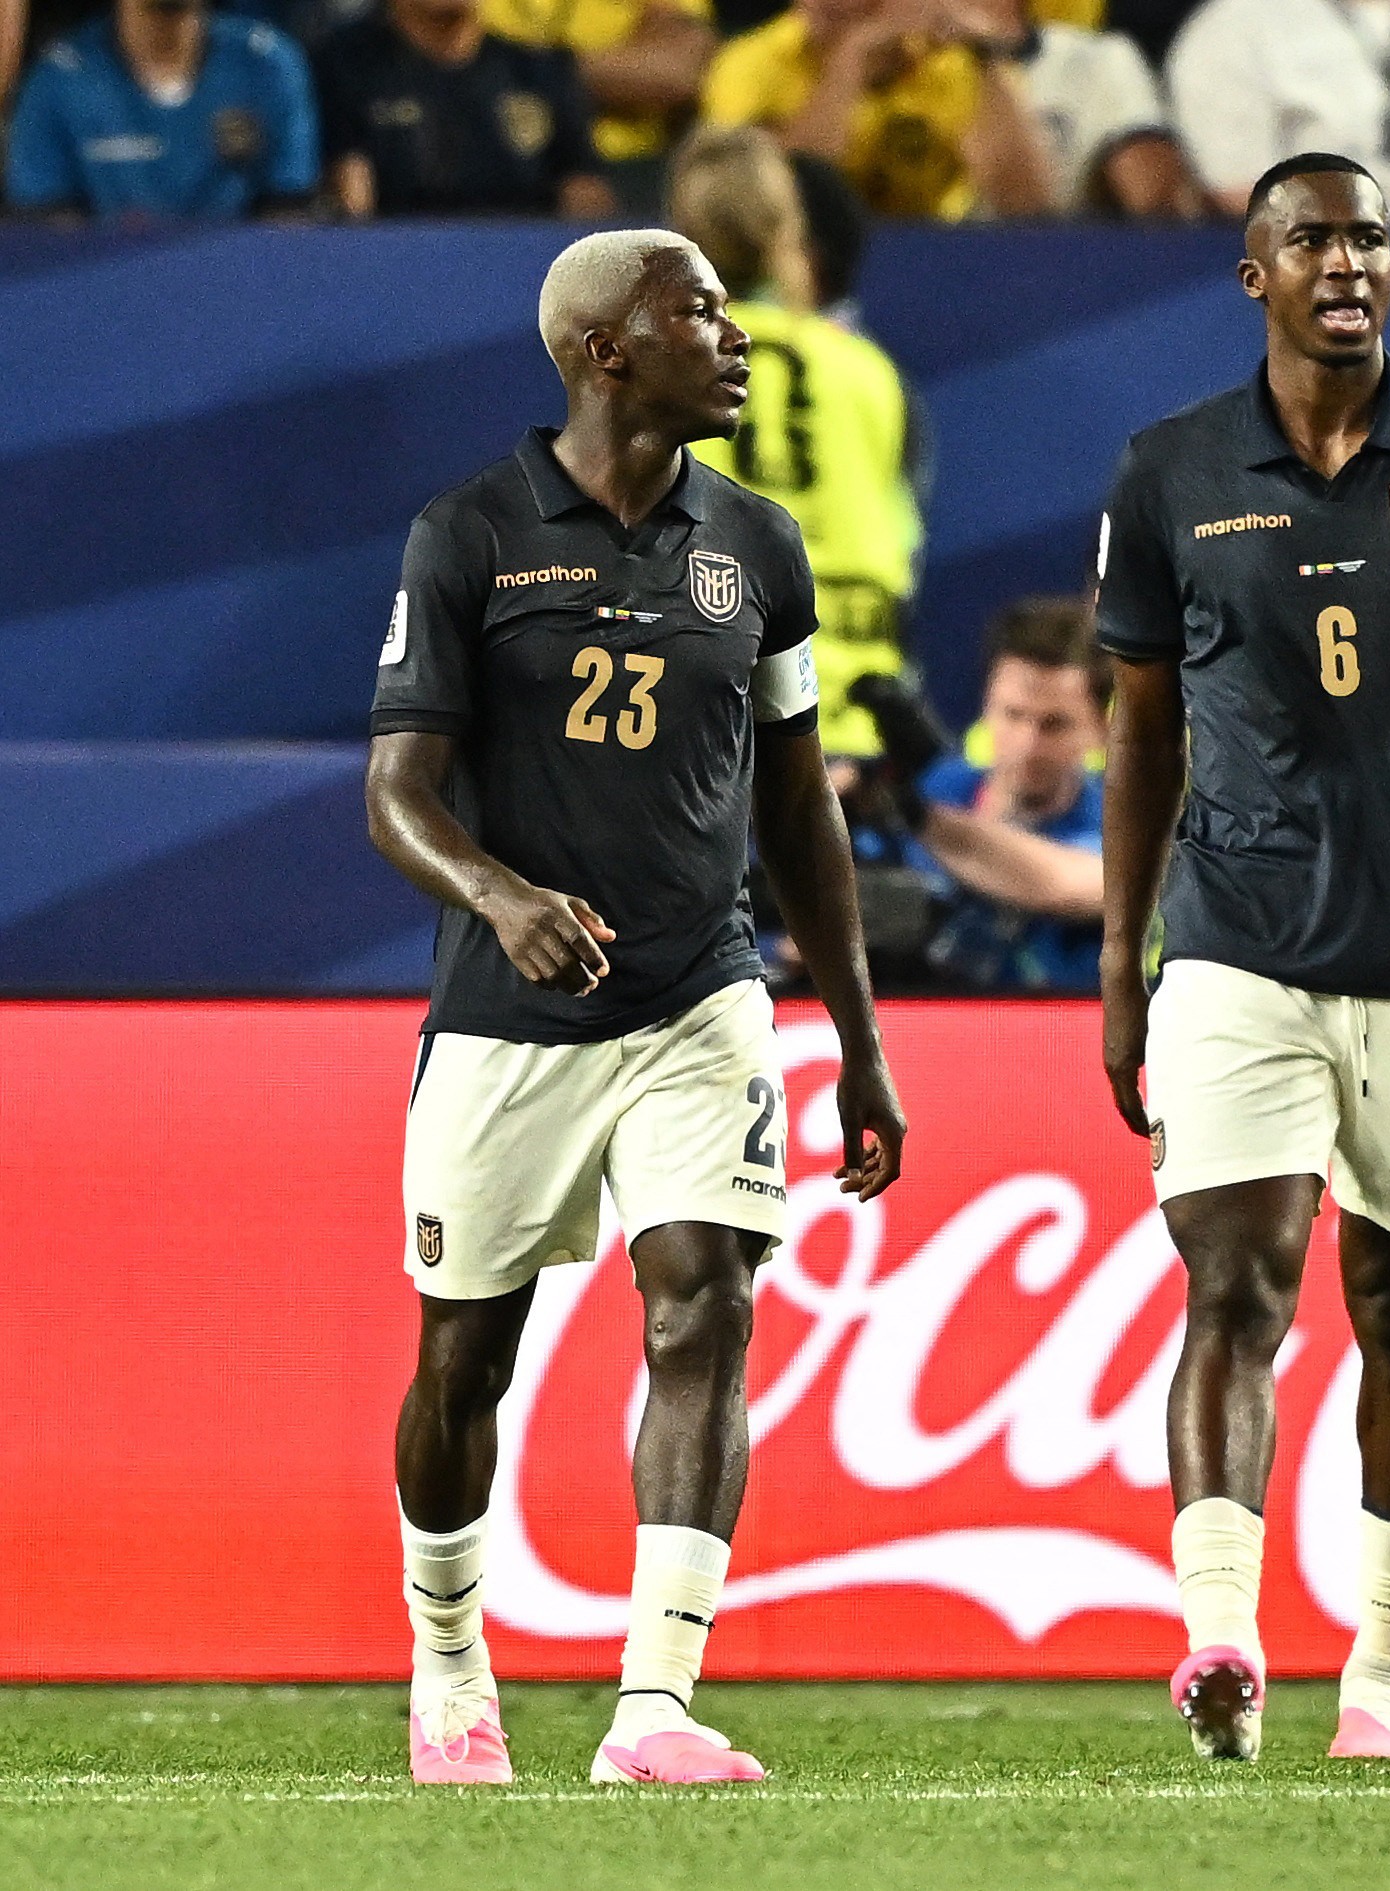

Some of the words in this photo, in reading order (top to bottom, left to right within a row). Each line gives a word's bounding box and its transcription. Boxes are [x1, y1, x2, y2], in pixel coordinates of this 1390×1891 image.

[1194, 513, 1292, 539] marathon
[495, 564, 597, 589] marathon
[1315, 605, 1361, 697] 6
[565, 646, 665, 750] 23
[743, 1076, 785, 1169] 2
